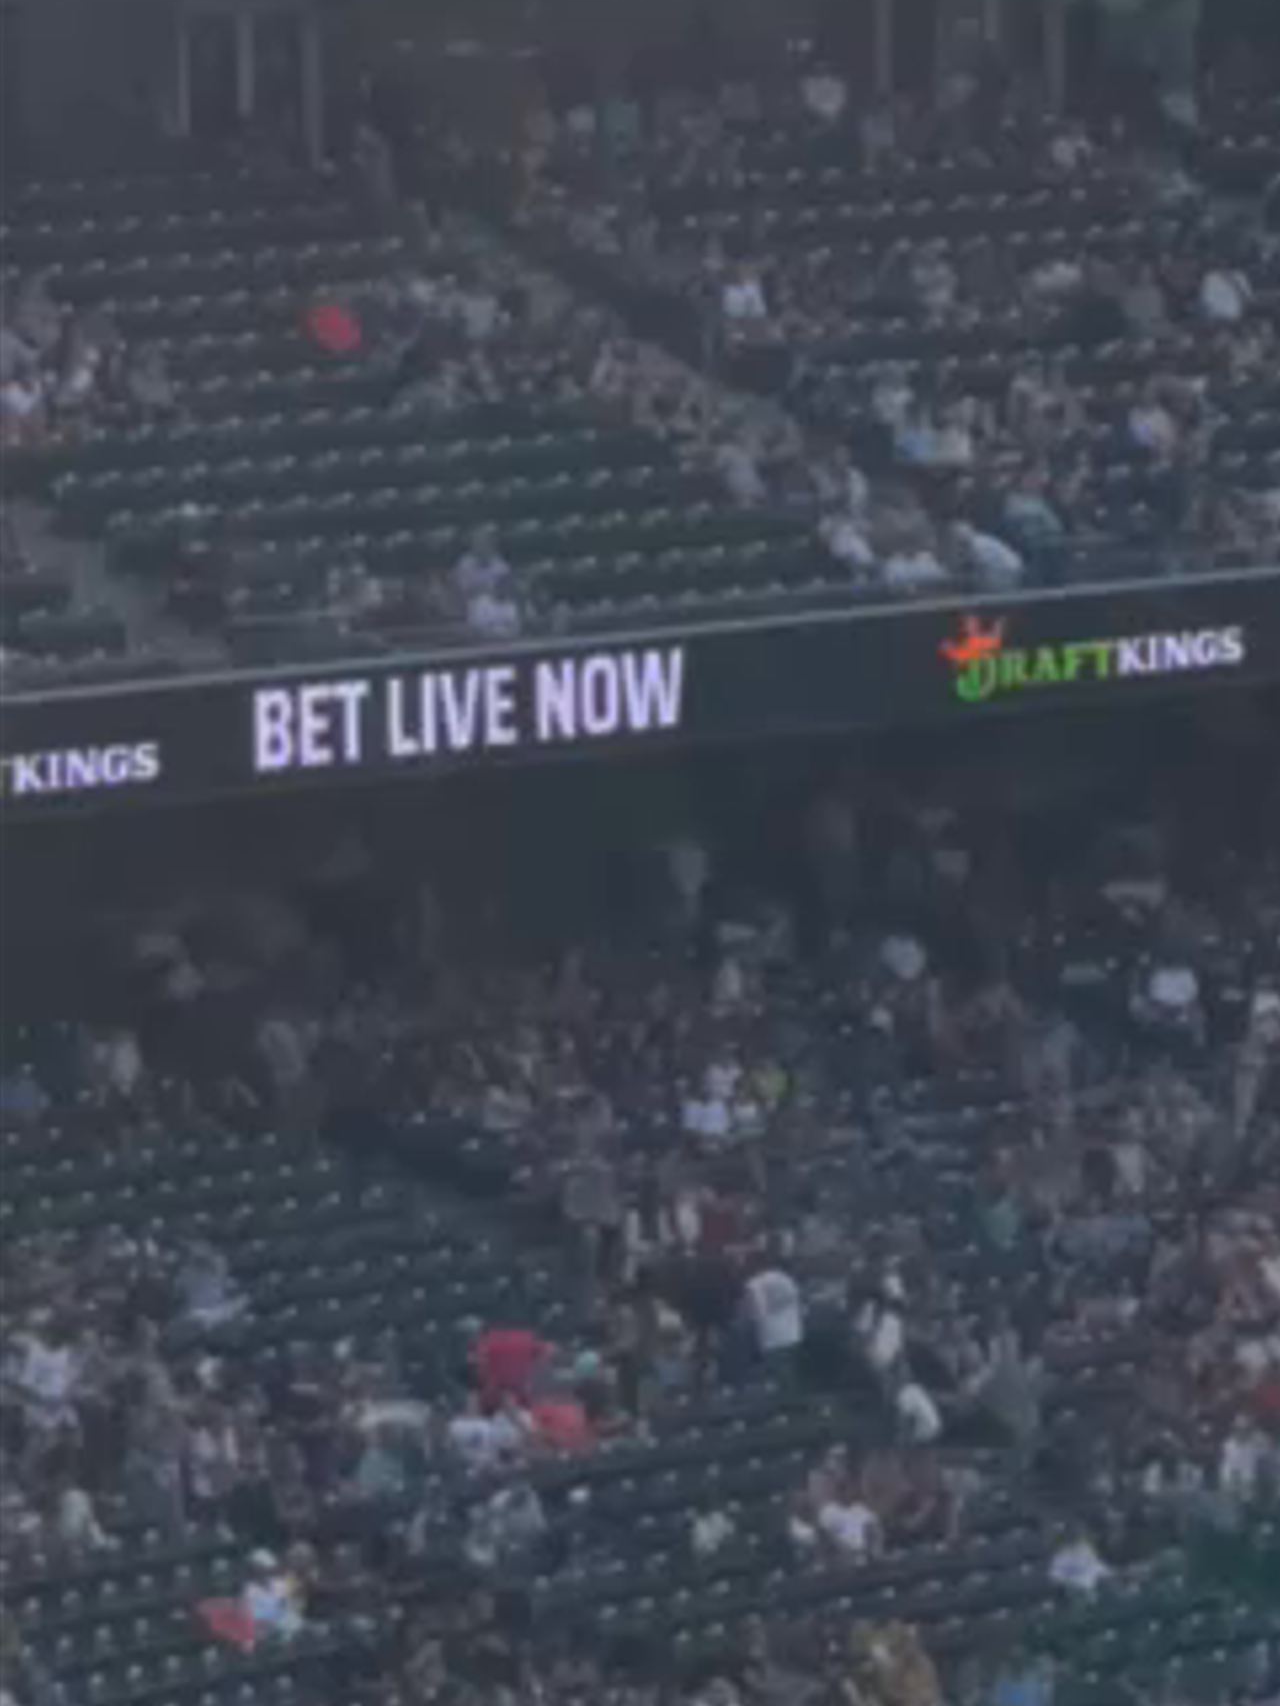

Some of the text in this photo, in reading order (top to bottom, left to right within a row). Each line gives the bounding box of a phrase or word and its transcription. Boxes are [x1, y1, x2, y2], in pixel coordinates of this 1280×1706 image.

[253, 648, 685, 772] BET LIVE NOW
